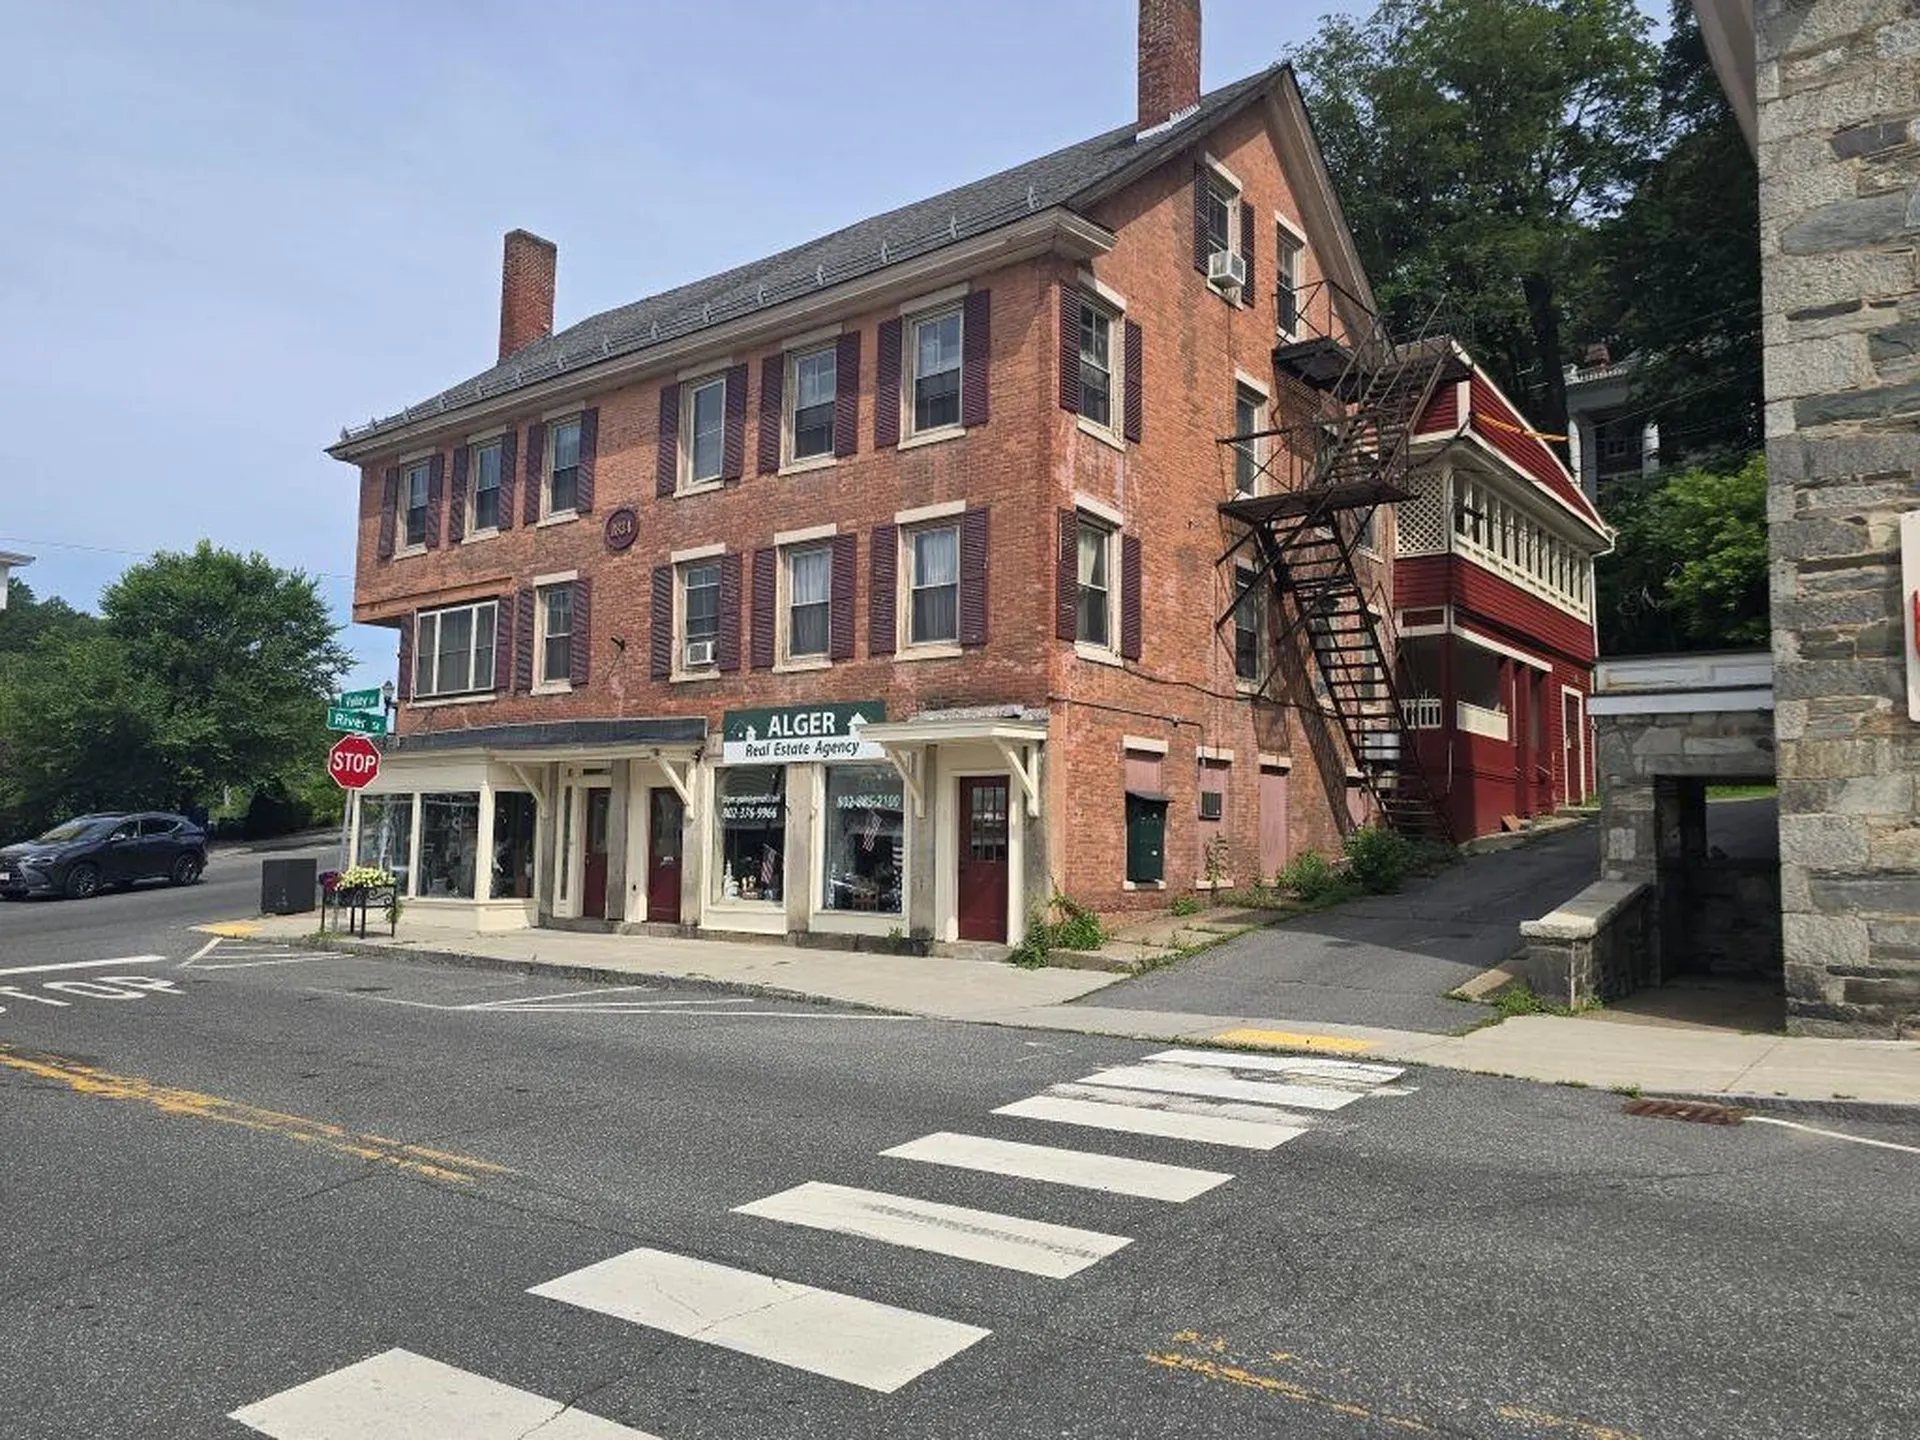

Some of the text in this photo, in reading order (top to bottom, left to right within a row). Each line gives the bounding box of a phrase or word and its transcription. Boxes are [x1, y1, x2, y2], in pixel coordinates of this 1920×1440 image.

[335, 713, 366, 729] River
[767, 711, 835, 737] ALGER
[745, 740, 860, 758] Real Estate Agency
[332, 751, 376, 773] STOP
[0, 976, 186, 1014] TOP
